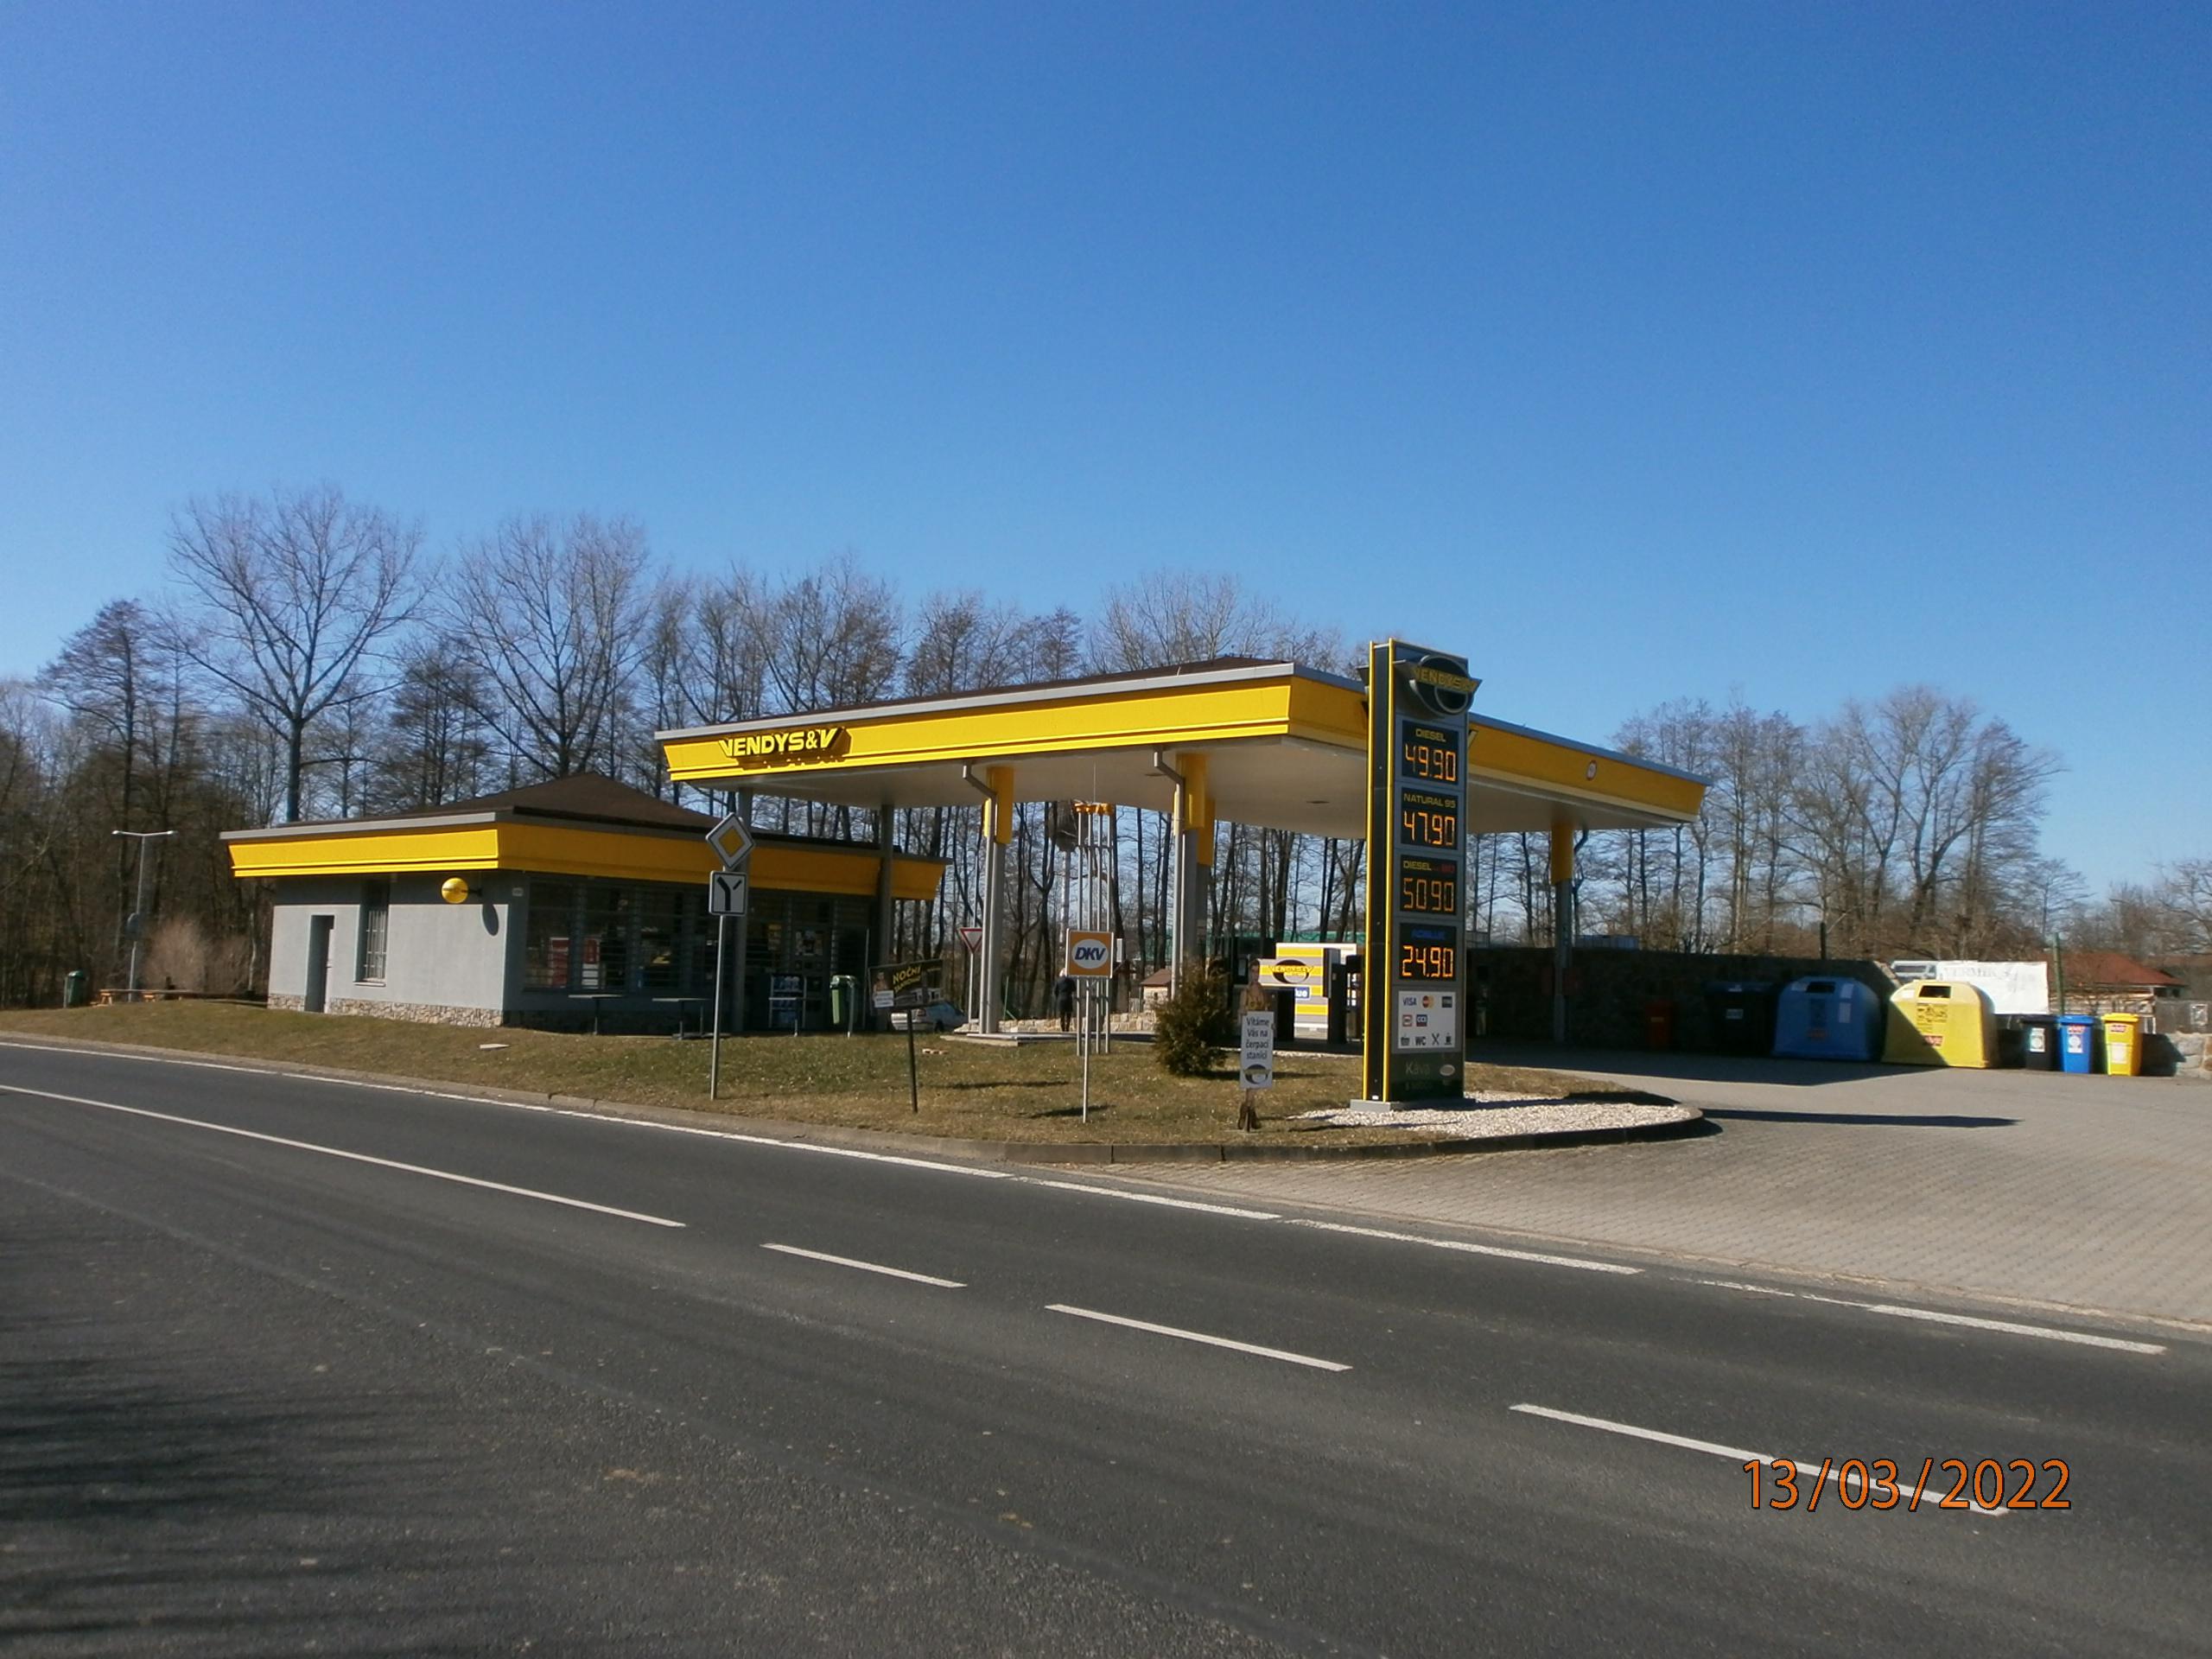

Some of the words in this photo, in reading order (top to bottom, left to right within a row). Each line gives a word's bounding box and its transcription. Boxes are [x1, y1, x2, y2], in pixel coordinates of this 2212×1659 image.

[1415, 728, 1446, 742] DIESEL
[719, 728, 837, 757] VENDYS&V
[1403, 793, 1444, 807] NATURAL
[1444, 799, 1456, 809] 95
[1403, 861, 1432, 871] DIESEL
[1074, 946, 1106, 961] DKV
[1403, 997, 1417, 1007] VISA
[1415, 1036, 1427, 1046] WC
